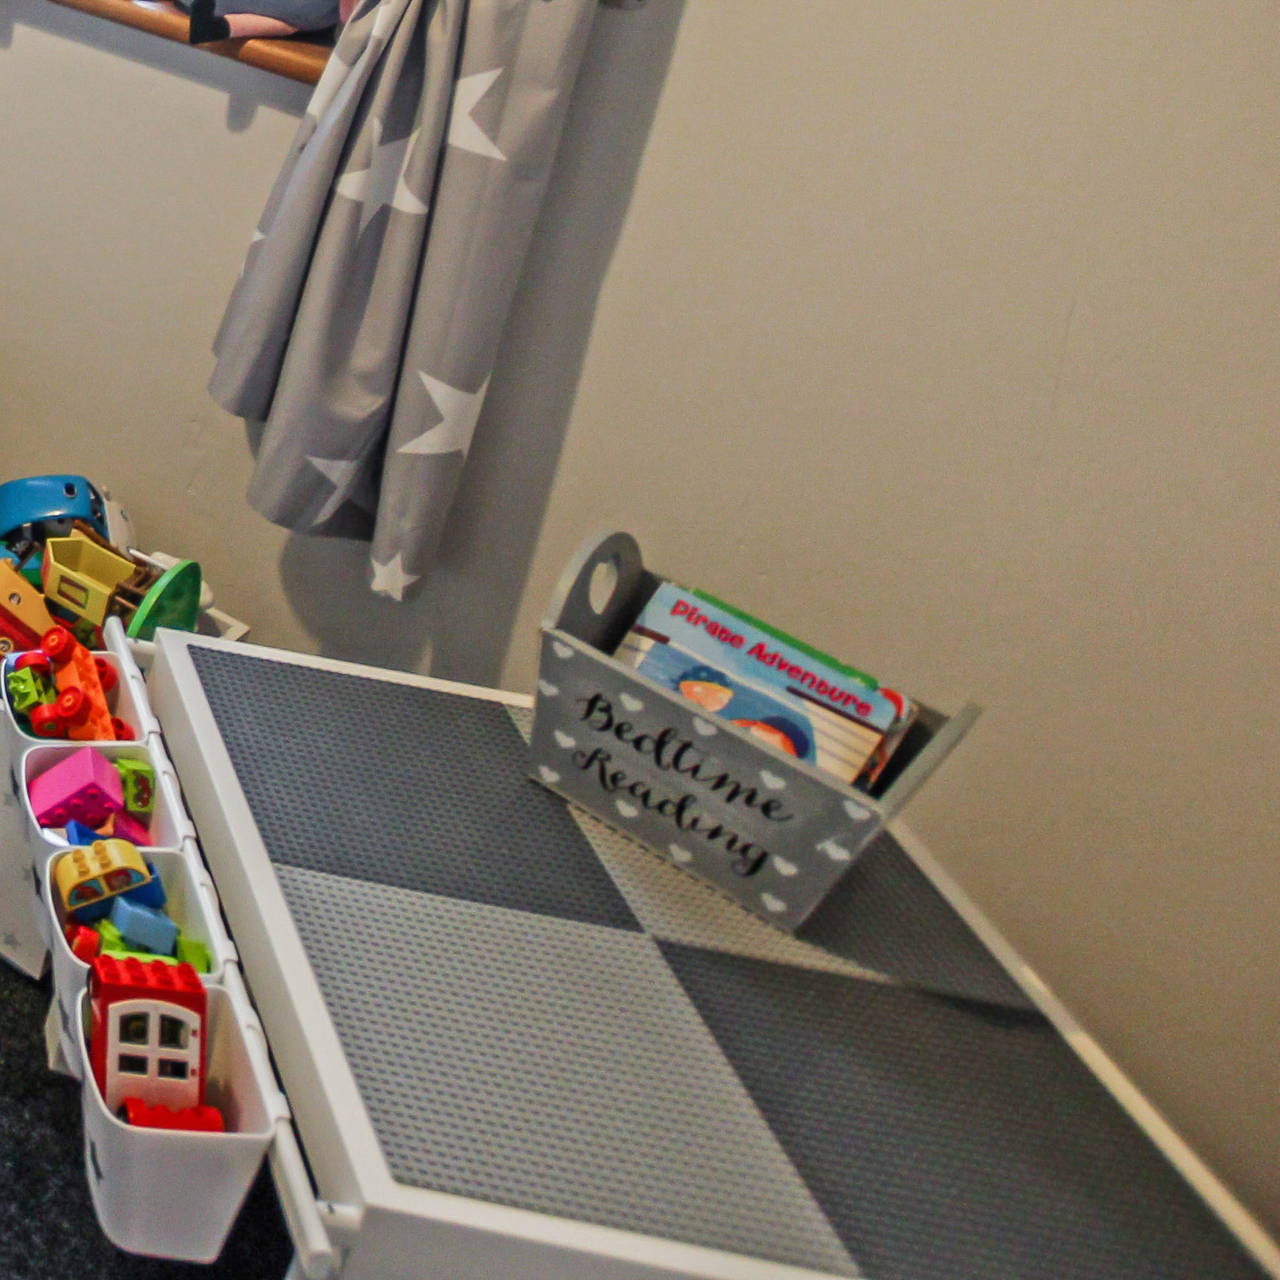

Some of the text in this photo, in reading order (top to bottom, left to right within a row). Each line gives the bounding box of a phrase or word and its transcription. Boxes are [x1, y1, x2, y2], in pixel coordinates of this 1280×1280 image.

[670, 599, 874, 717] Pirate Adventure
[572, 747, 769, 878] Reading
[576, 693, 794, 822] Bedtime
